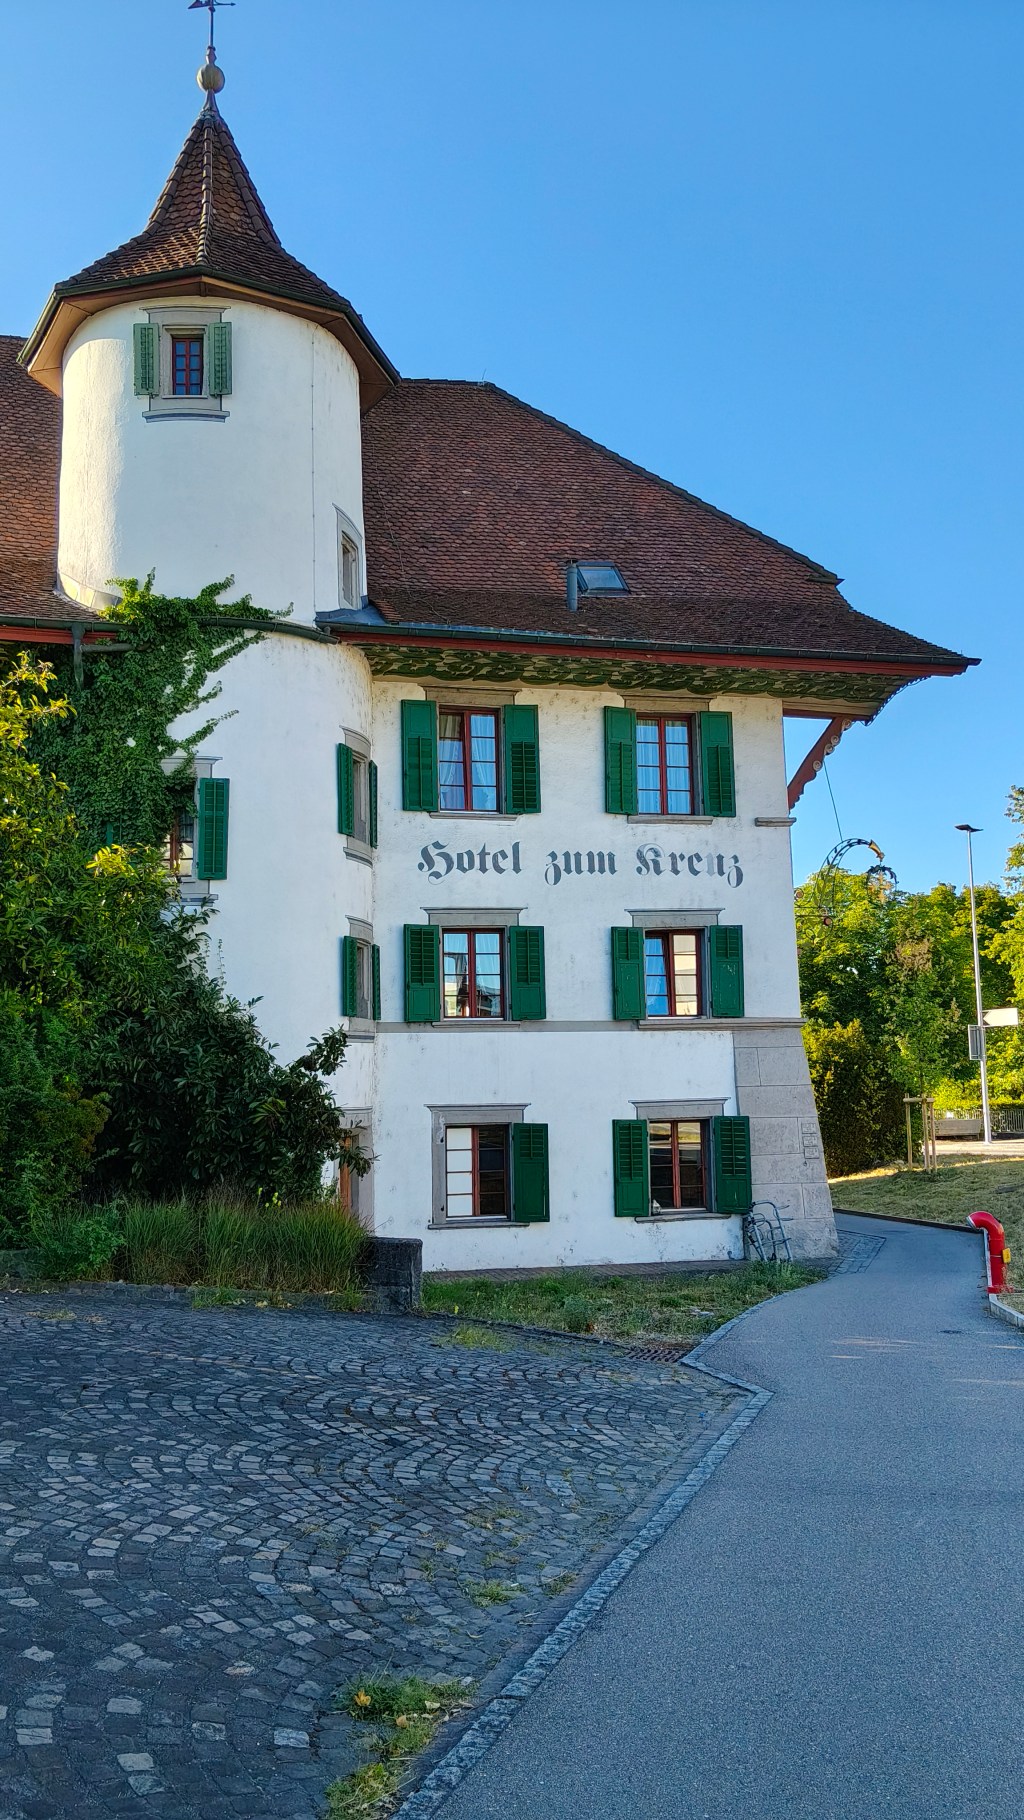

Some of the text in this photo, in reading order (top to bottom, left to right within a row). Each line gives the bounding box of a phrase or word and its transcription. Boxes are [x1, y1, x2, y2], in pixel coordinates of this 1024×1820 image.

[417, 840, 744, 888] Hotel zum Kreuz
